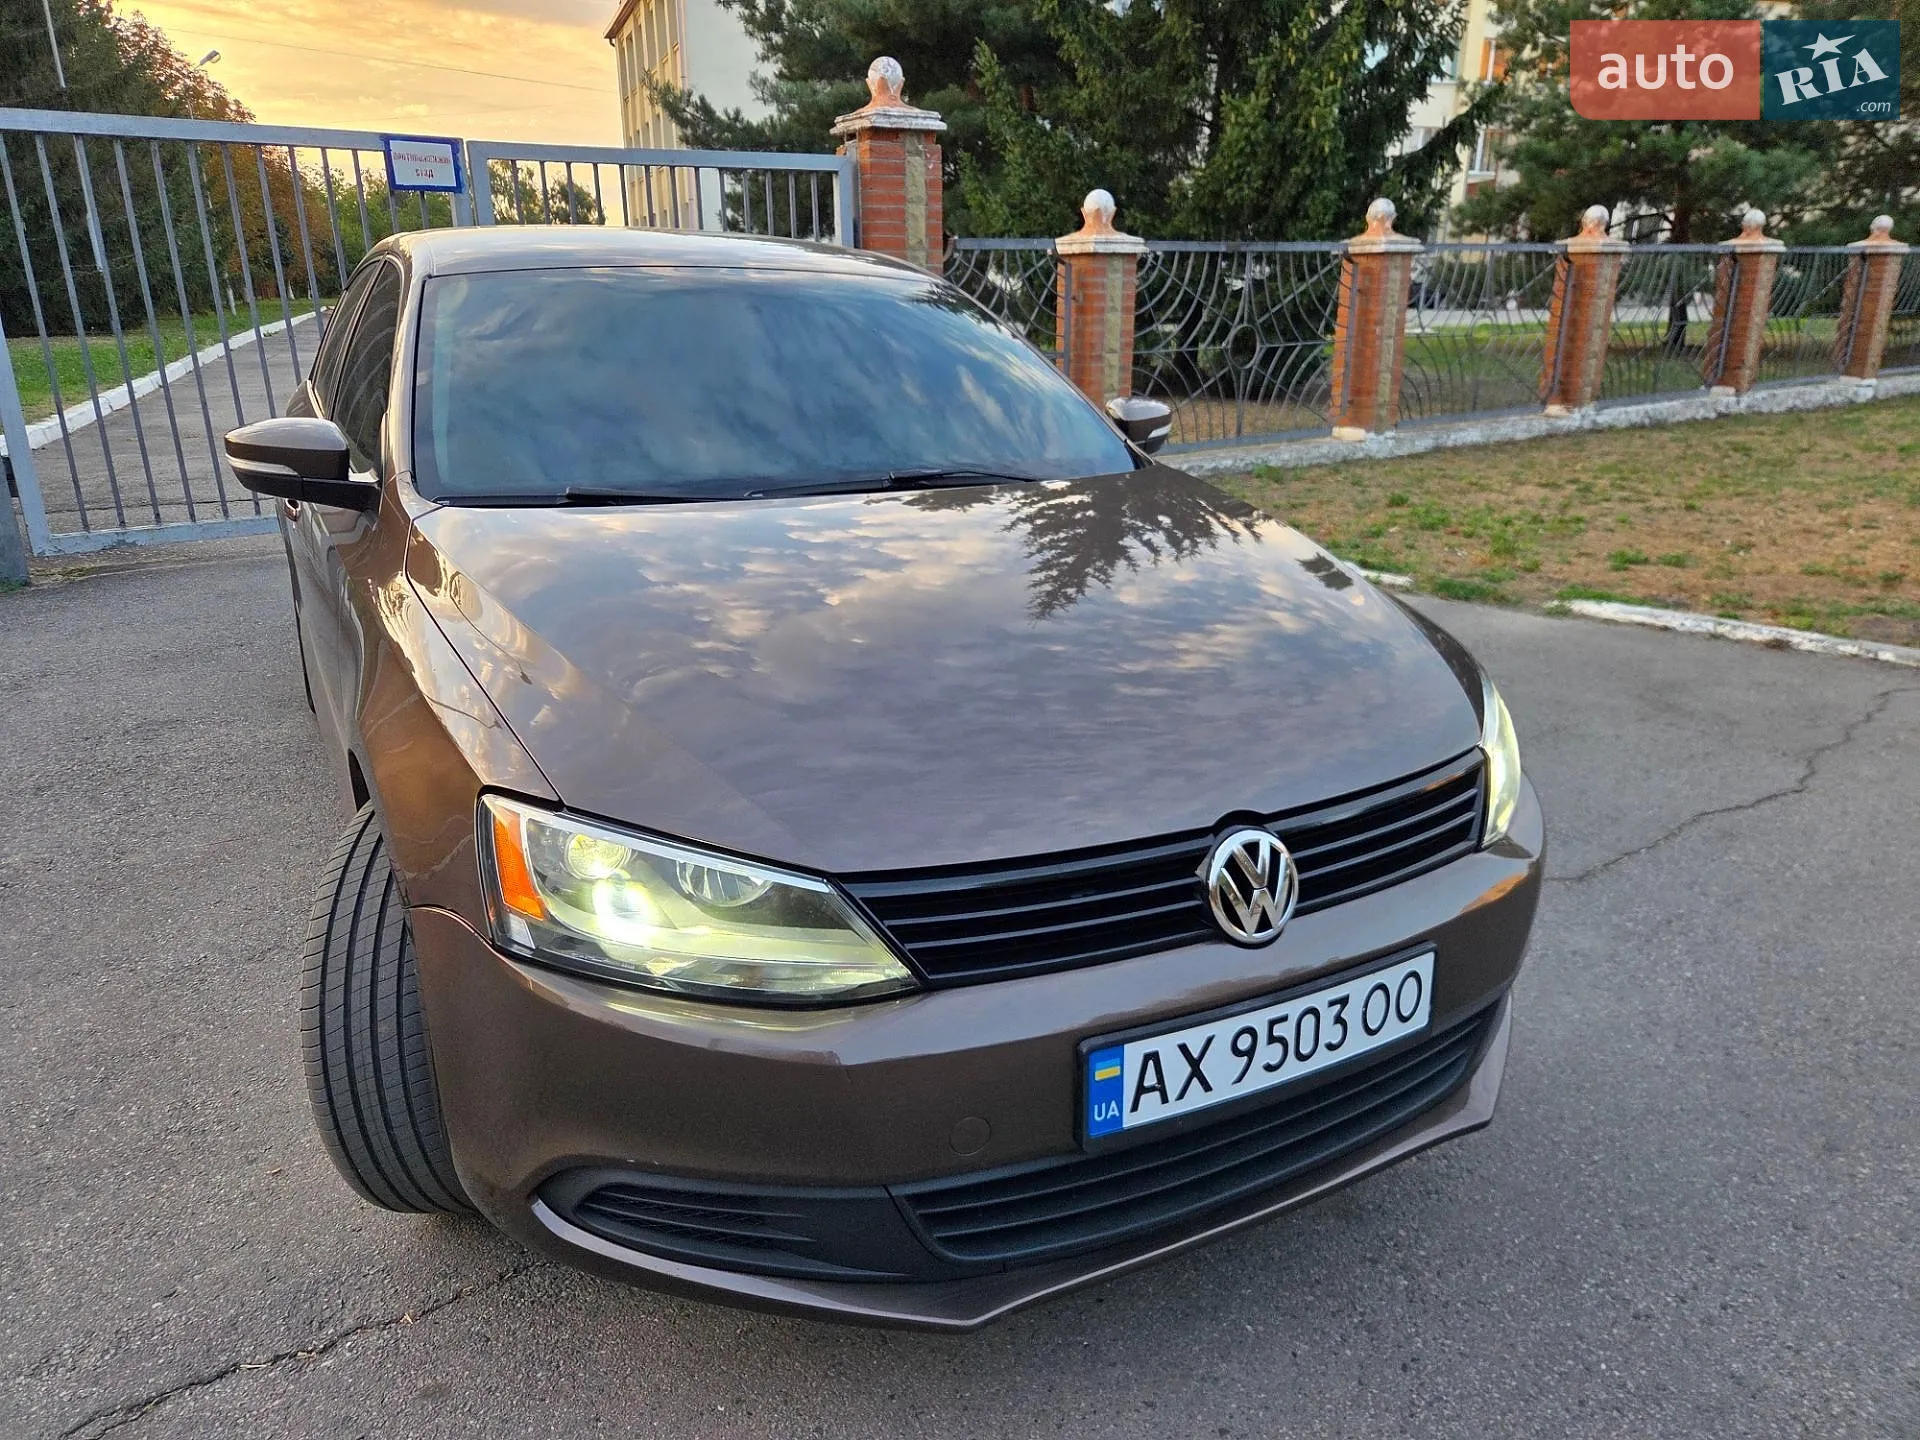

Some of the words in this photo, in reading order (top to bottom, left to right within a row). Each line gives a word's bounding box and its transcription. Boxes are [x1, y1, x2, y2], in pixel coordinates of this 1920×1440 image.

[1129, 1034, 1216, 1113] AX
[1230, 995, 1349, 1085] 9503
[1361, 969, 1423, 1037] OO
[1093, 1099, 1120, 1122] UA
